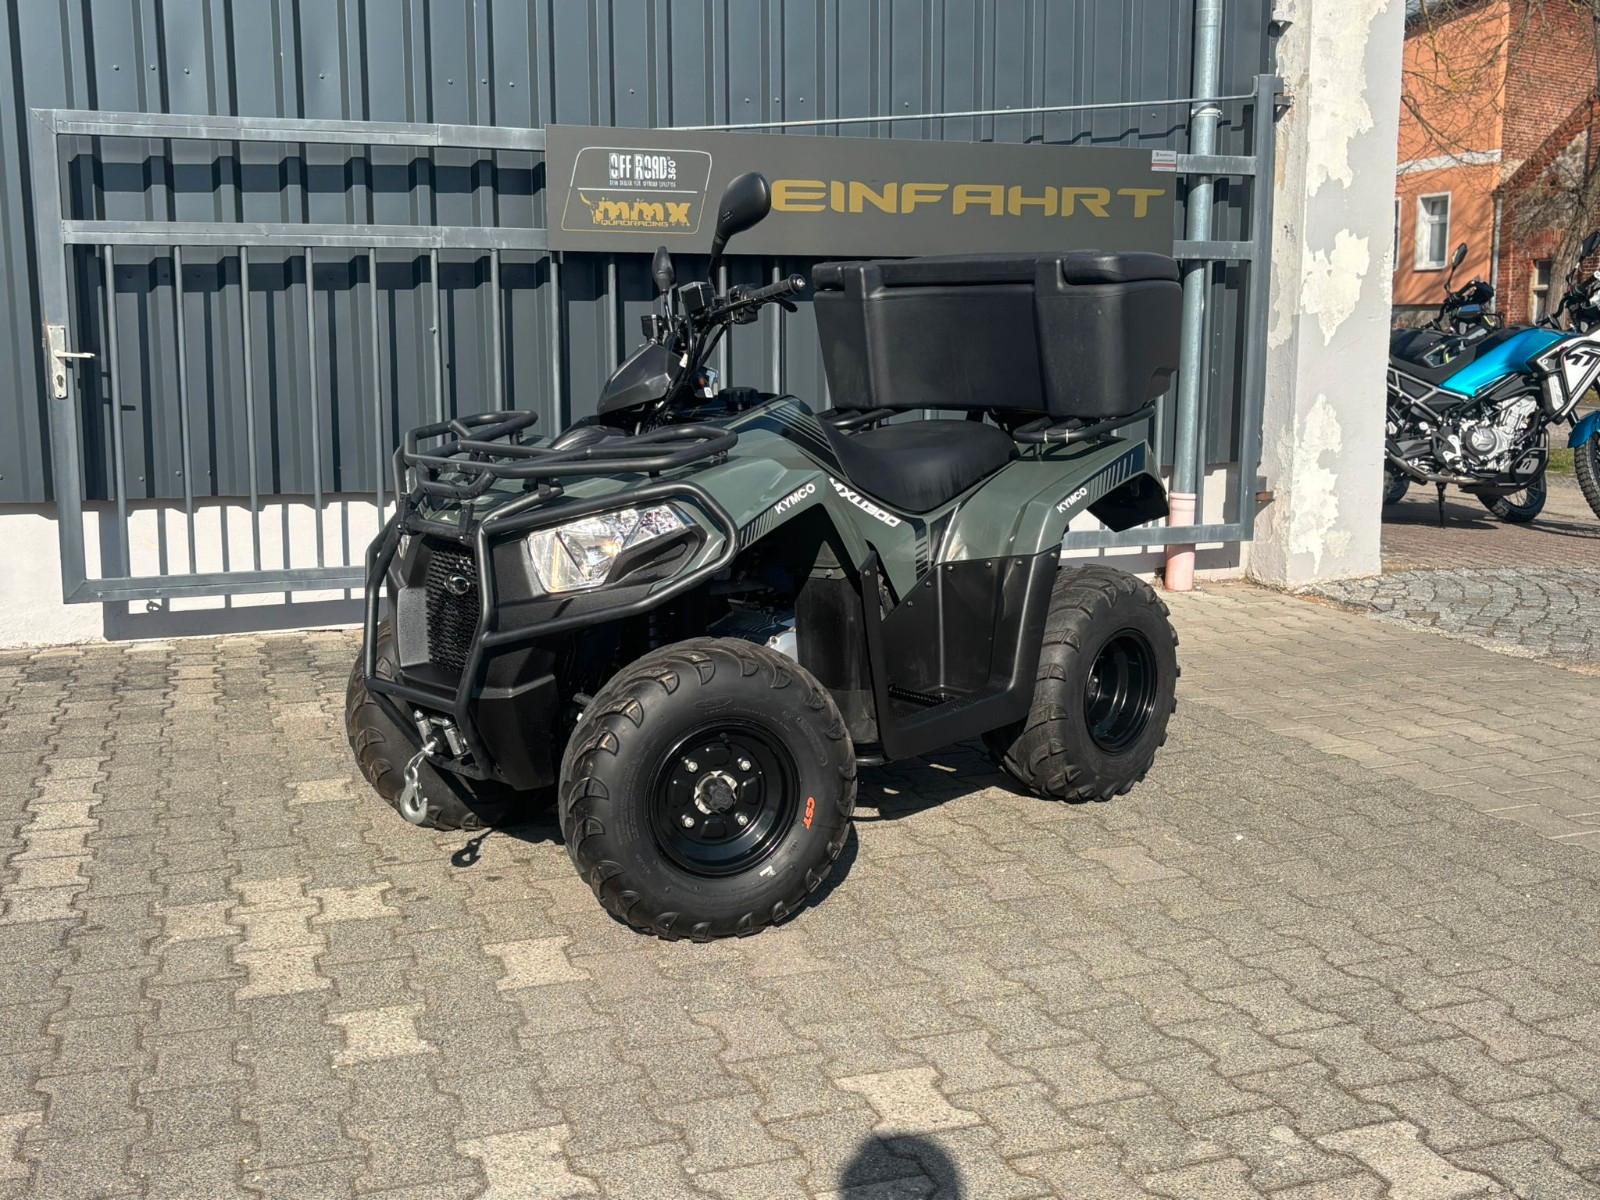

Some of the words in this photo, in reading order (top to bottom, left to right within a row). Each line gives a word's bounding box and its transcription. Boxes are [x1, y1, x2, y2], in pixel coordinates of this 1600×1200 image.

[608, 153, 632, 179] OFF
[634, 154, 667, 179] ROAD
[771, 179, 1166, 218] EINFAHRT
[774, 483, 816, 515] KYMCO
[1056, 487, 1088, 513] KYMCO
